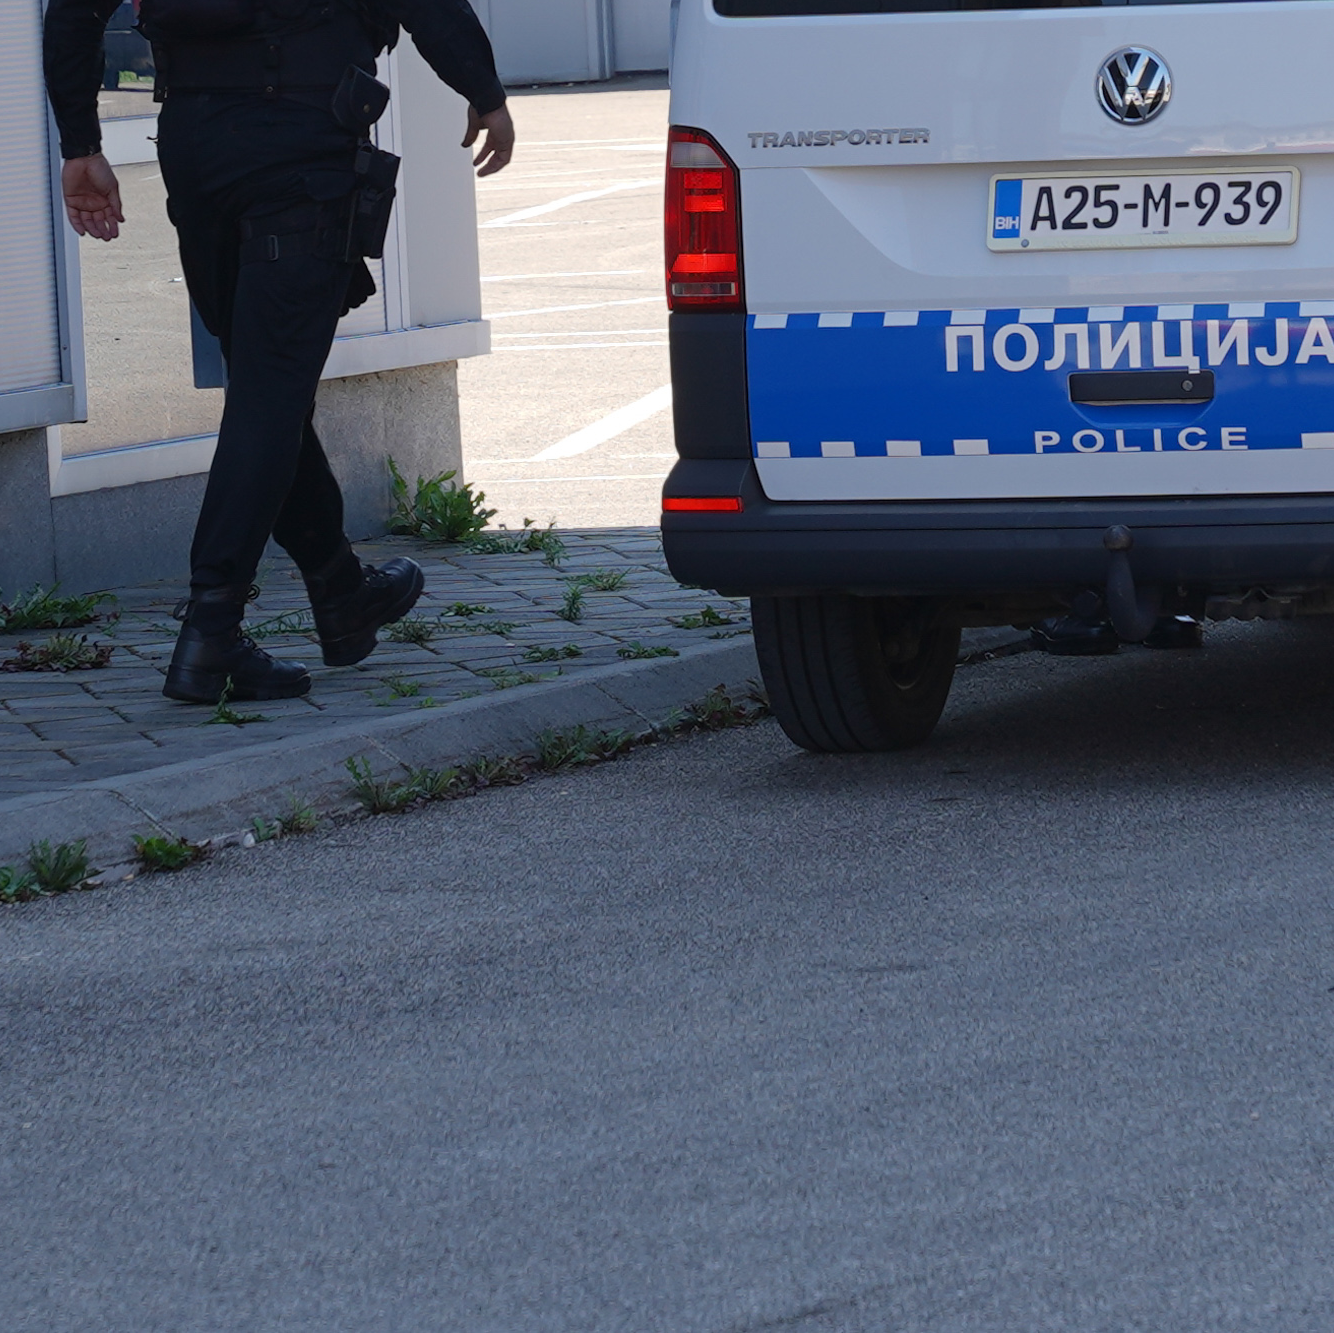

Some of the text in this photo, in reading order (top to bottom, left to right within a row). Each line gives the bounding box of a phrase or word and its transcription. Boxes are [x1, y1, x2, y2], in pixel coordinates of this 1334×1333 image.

[747, 127, 931, 148] TRANSPORTER
[1030, 180, 1283, 231] A25-M-939
[994, 216, 1020, 230] BIH
[1034, 426, 1249, 454] POLICE
